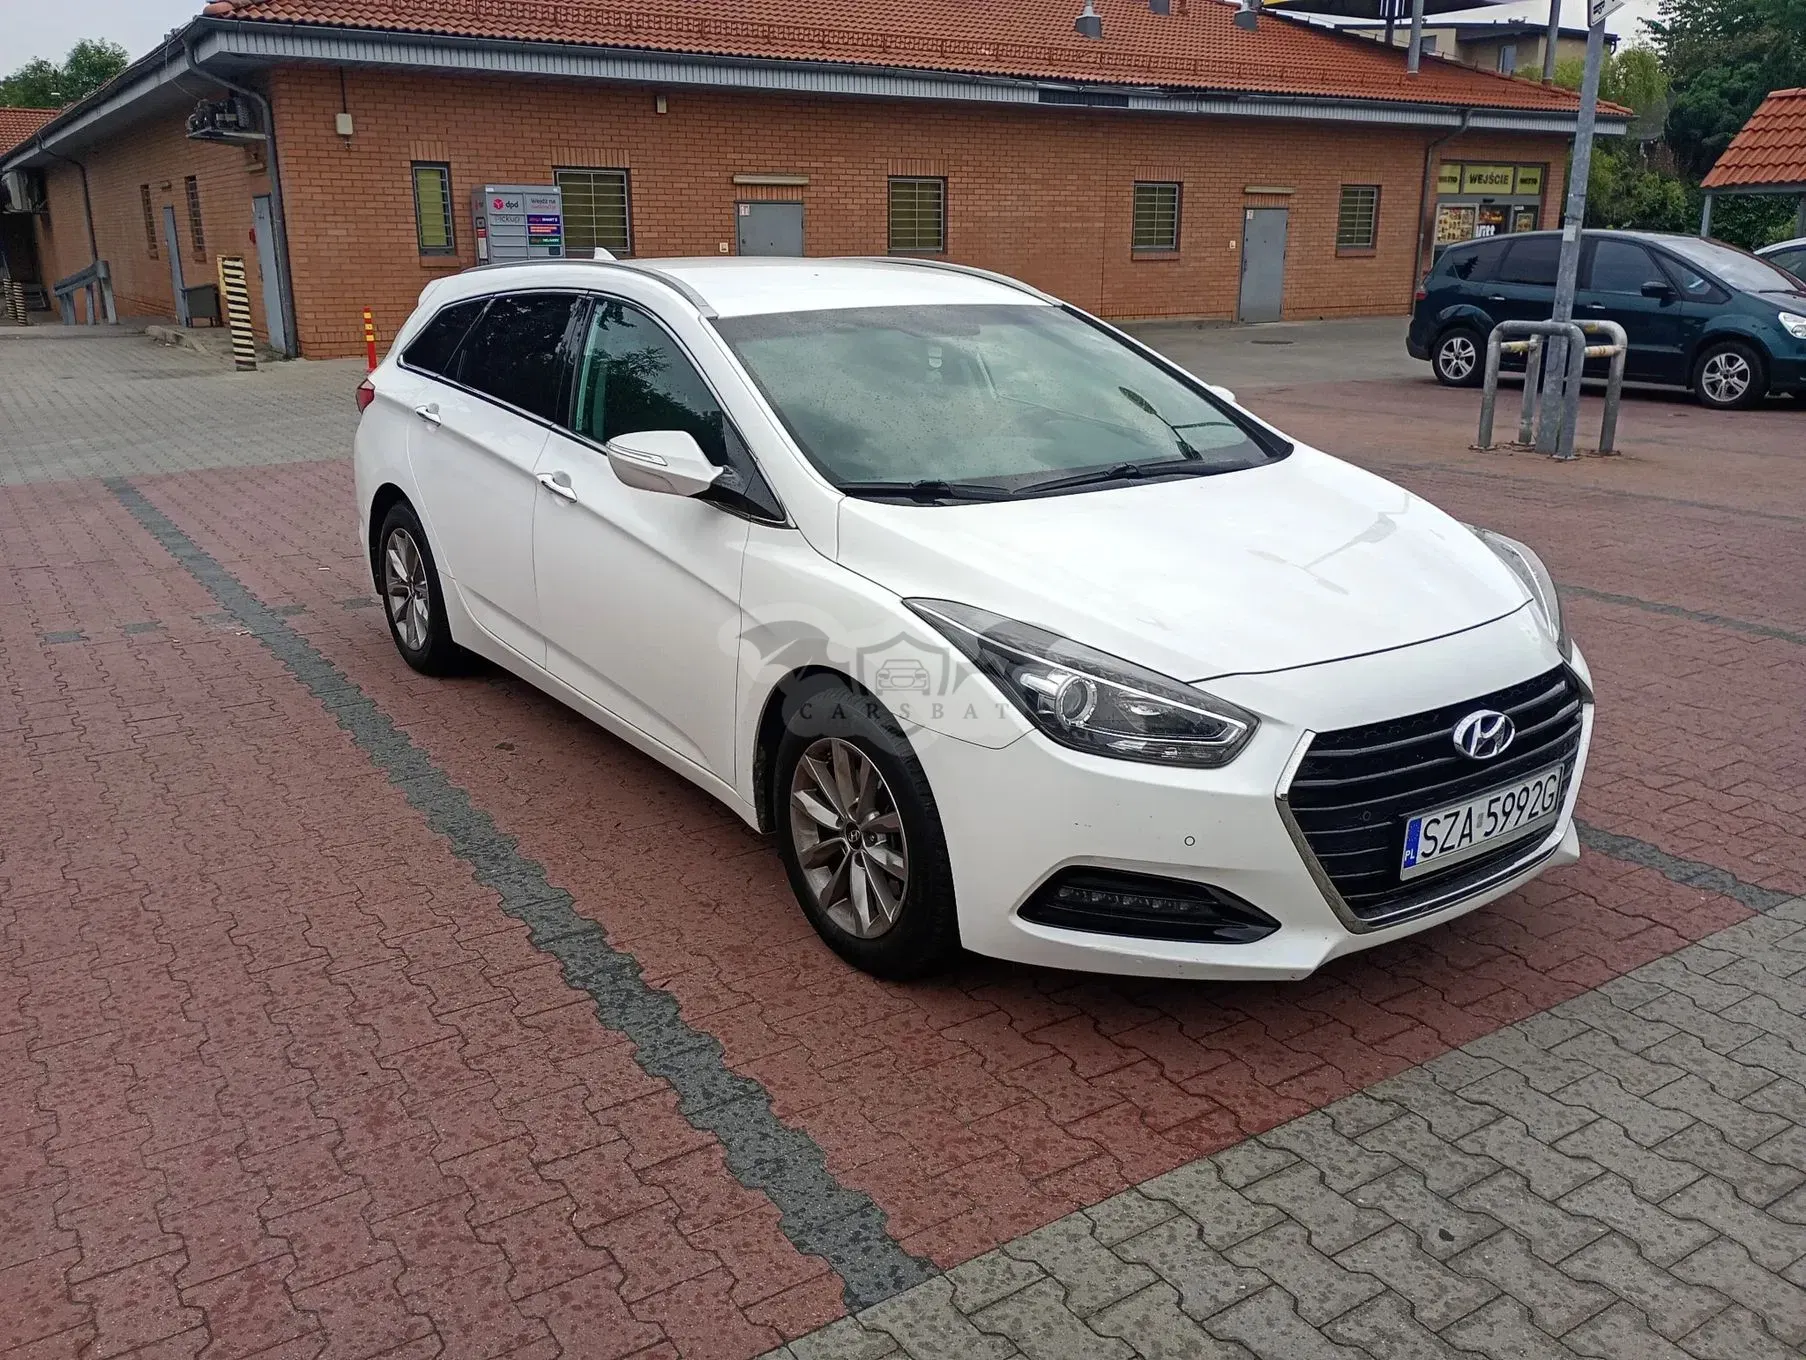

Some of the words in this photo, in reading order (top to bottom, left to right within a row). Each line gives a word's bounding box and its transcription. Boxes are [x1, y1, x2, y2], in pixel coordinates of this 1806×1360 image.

[1469, 171, 1509, 185] WEJŚCIE
[505, 200, 519, 209] dpd
[1421, 806, 1473, 858] SZA
[1484, 774, 1557, 837] 5992G
[1404, 849, 1415, 861] PL
